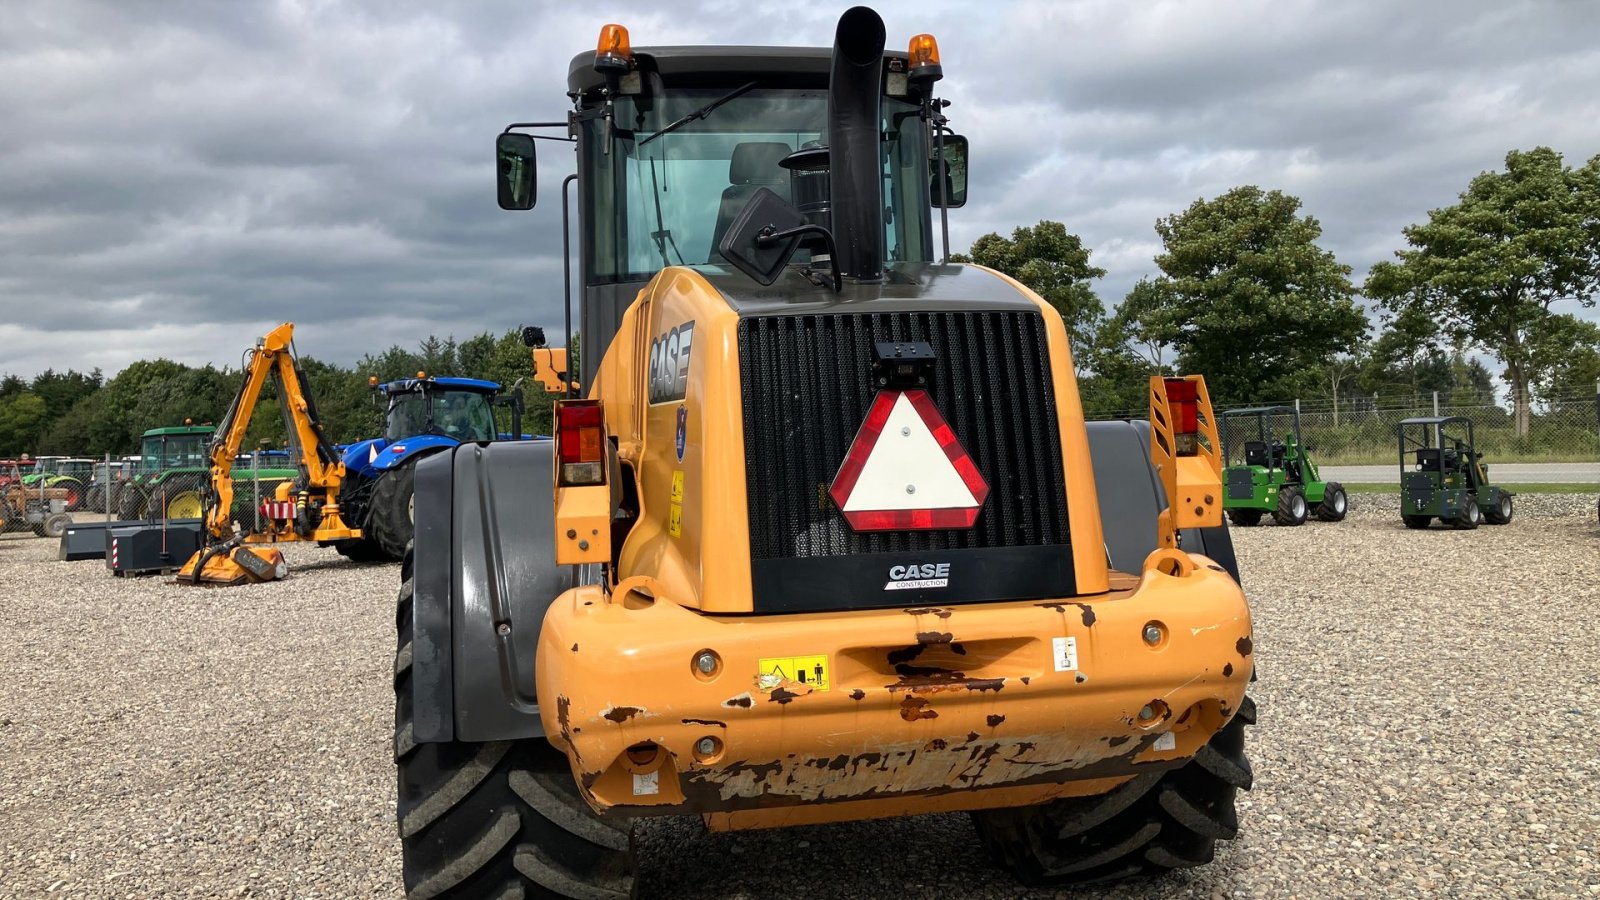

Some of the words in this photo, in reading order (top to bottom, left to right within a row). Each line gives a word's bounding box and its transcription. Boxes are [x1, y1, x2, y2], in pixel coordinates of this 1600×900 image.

[648, 324, 694, 402] CASE
[889, 563, 951, 580] CASE
[896, 580, 946, 588] CONSTRUCTION
